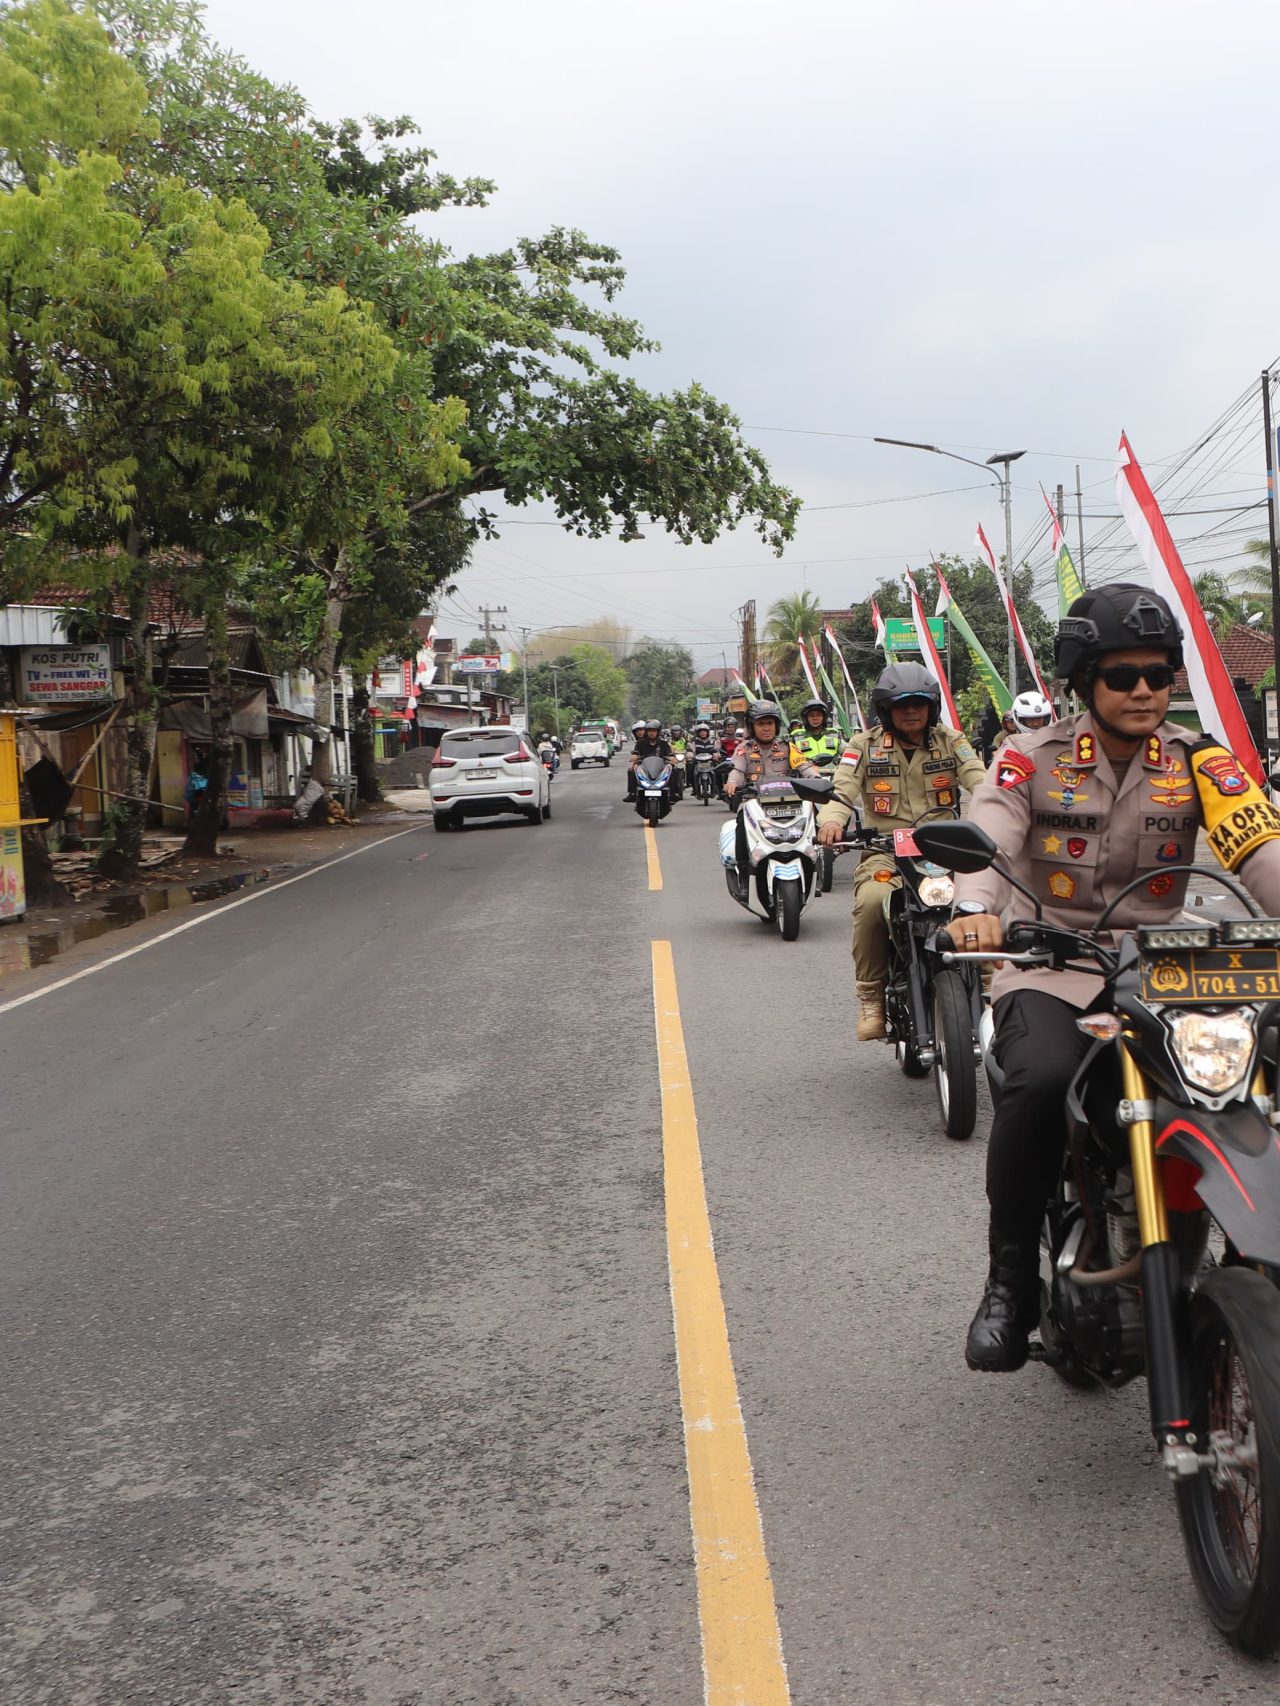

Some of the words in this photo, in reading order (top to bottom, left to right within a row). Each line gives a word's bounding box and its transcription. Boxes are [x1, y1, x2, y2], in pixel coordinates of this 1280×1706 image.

[32, 654, 57, 664] KOS
[63, 652, 99, 663] PUTRI
[26, 670, 41, 681] TV
[51, 670, 74, 679] FREE
[30, 682, 58, 692] SEWA
[60, 681, 106, 691] SANGGAR
[1036, 813, 1097, 831] INDRA.R
[1145, 816, 1197, 832] POLRI
[1211, 824, 1234, 850] KA
[1232, 804, 1269, 830] OPS
[1228, 954, 1243, 968] X
[1199, 976, 1237, 993] 704
[1255, 976, 1279, 993] 51
